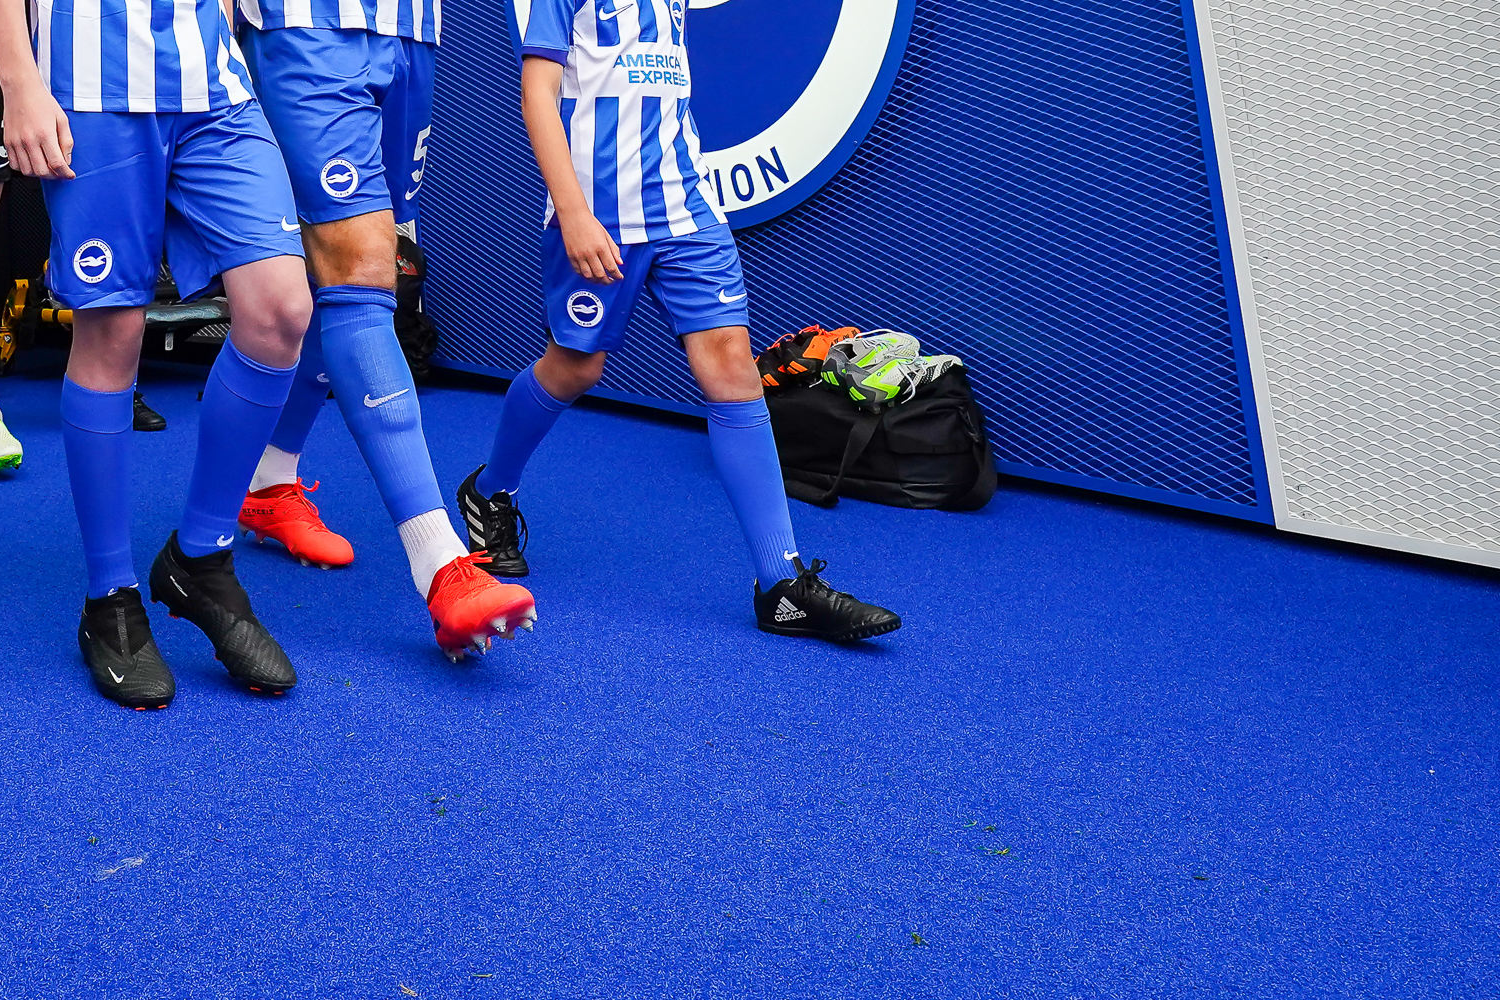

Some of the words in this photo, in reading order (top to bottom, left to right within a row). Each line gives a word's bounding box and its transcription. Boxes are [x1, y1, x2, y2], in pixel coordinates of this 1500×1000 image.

[612, 53, 682, 71] AMERICA
[411, 124, 432, 183] 5
[713, 146, 790, 207] ION
[774, 610, 807, 622] adidas
